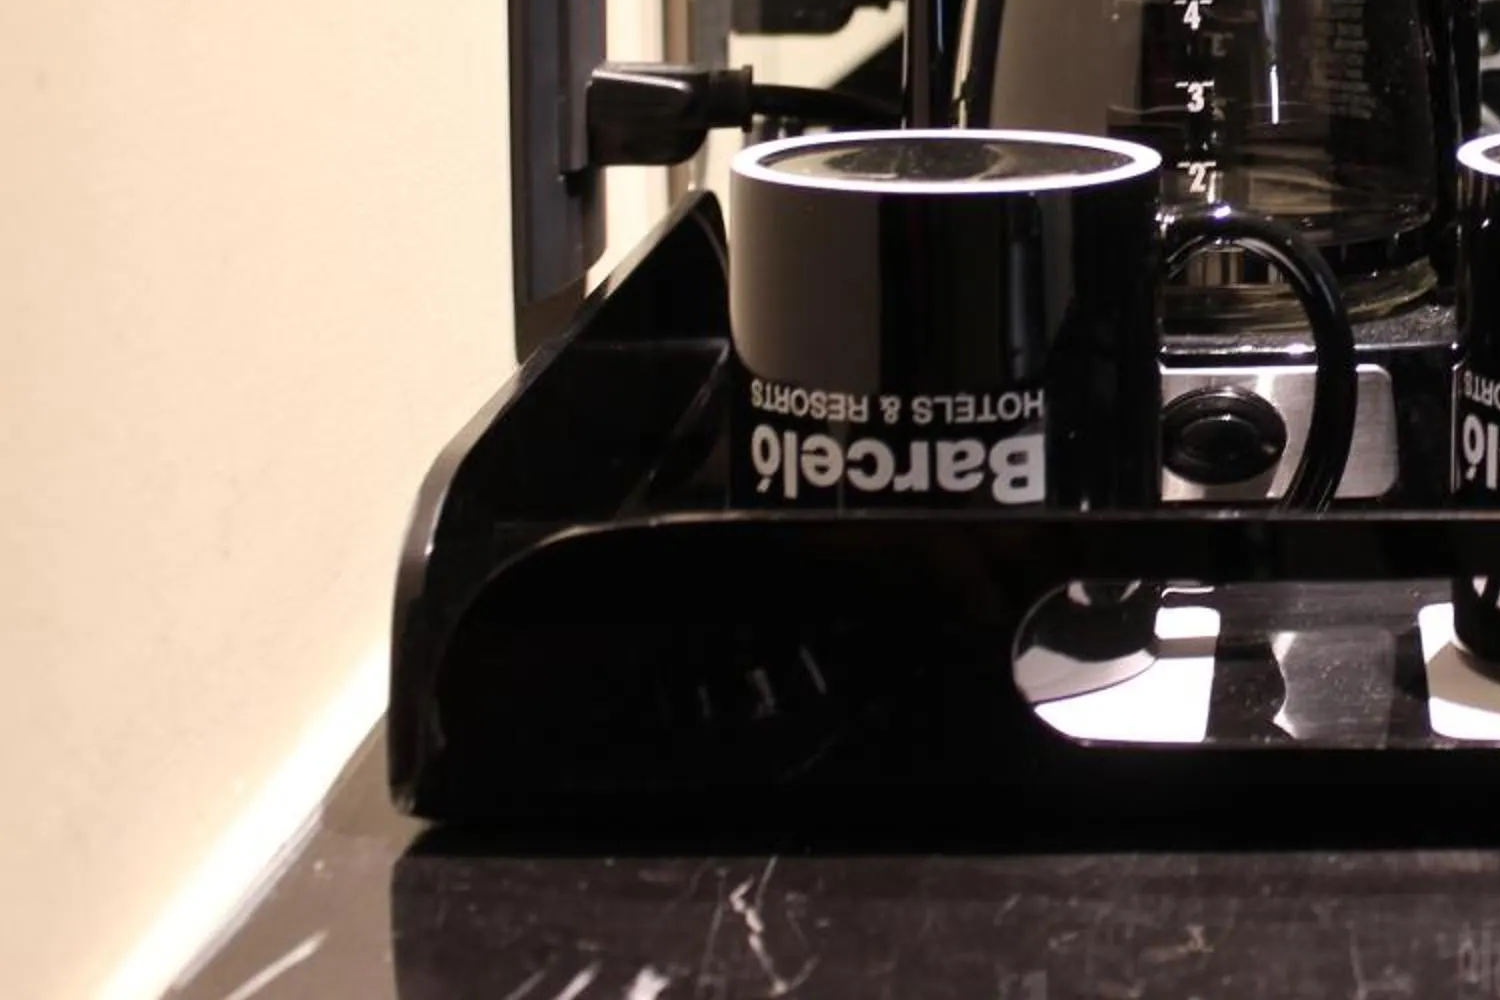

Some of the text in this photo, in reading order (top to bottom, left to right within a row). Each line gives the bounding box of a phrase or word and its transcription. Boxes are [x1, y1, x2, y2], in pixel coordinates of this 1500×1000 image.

[1183, 0, 1201, 29] 4
[1187, 83, 1205, 112] 3
[1188, 164, 1207, 193] 2
[751, 379, 1046, 425] HOTELS & RESORTS
[751, 423, 1046, 505] Barceló
